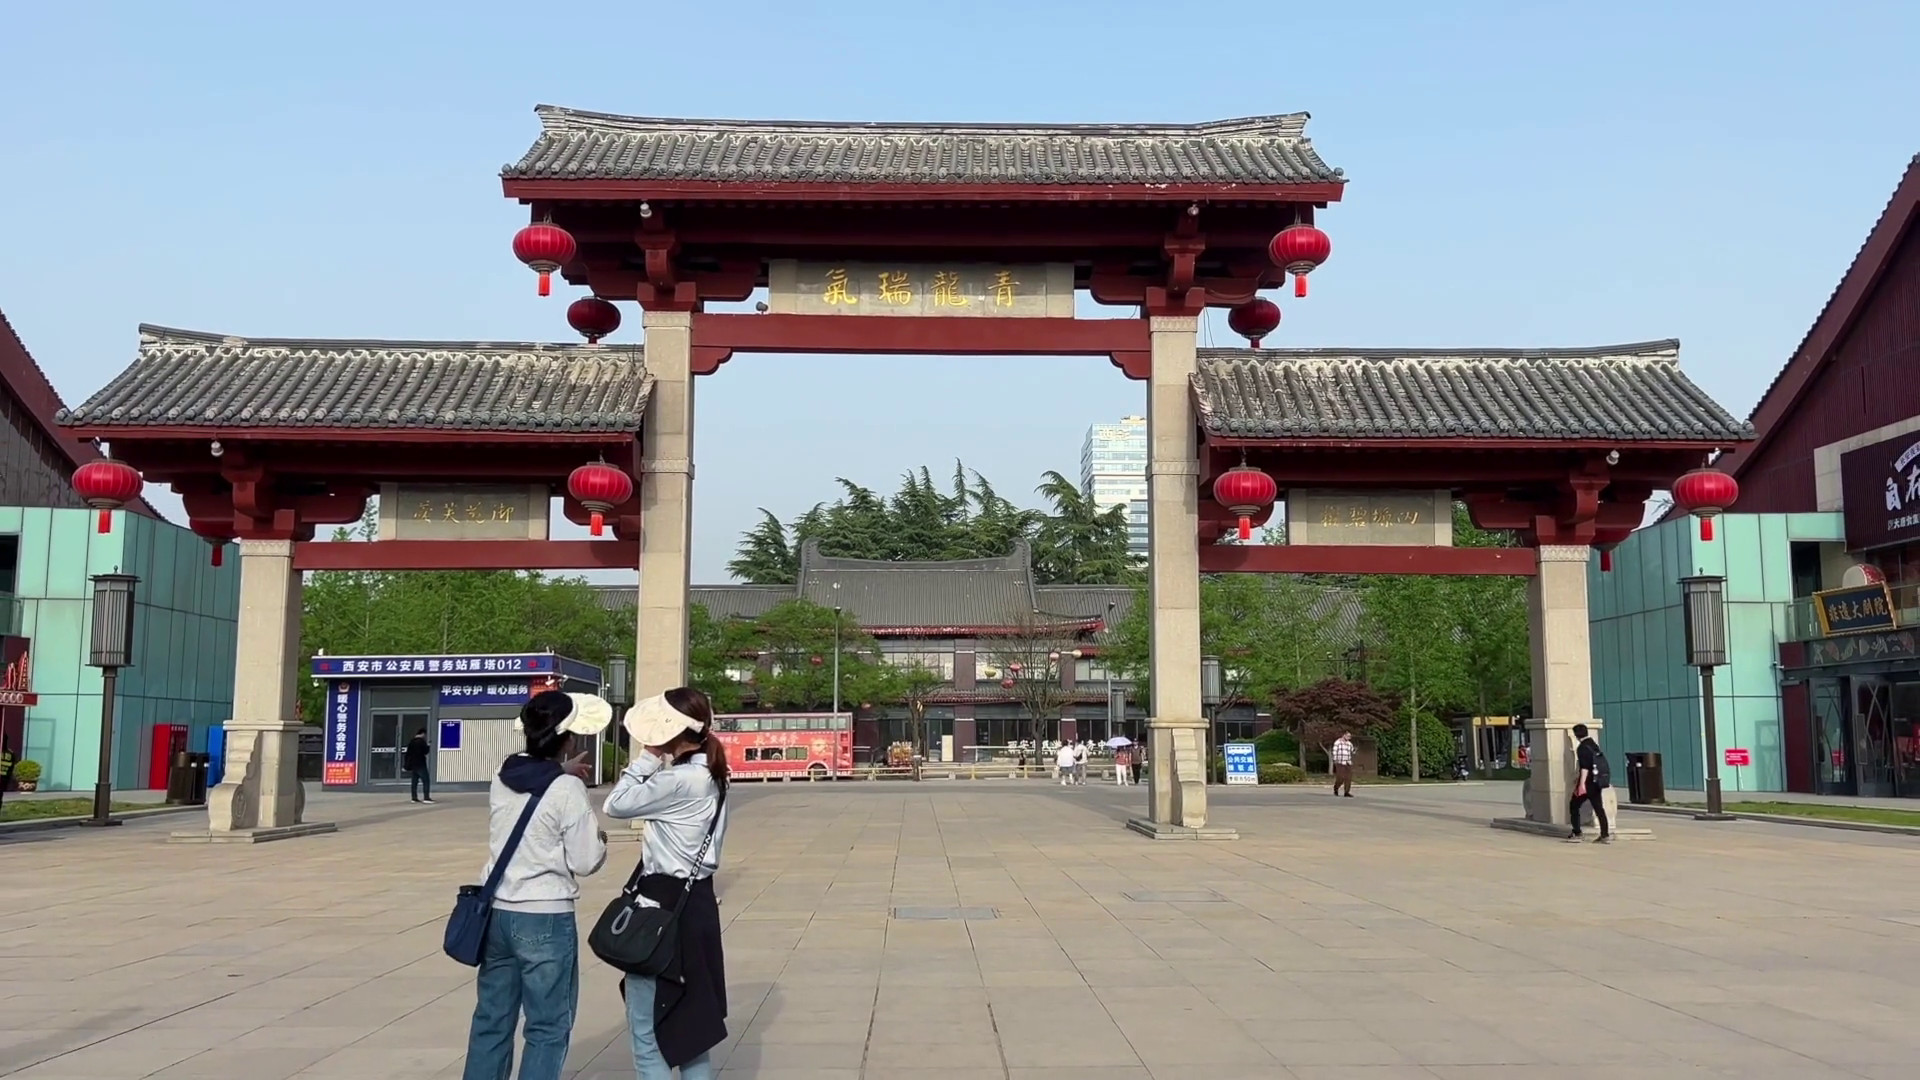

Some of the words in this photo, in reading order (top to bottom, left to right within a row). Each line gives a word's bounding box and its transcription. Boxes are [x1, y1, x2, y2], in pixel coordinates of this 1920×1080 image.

[441, 685, 483, 696] 平安守护
[487, 684, 528, 695] 暖心服务
[684, 833, 712, 892] FASHION
